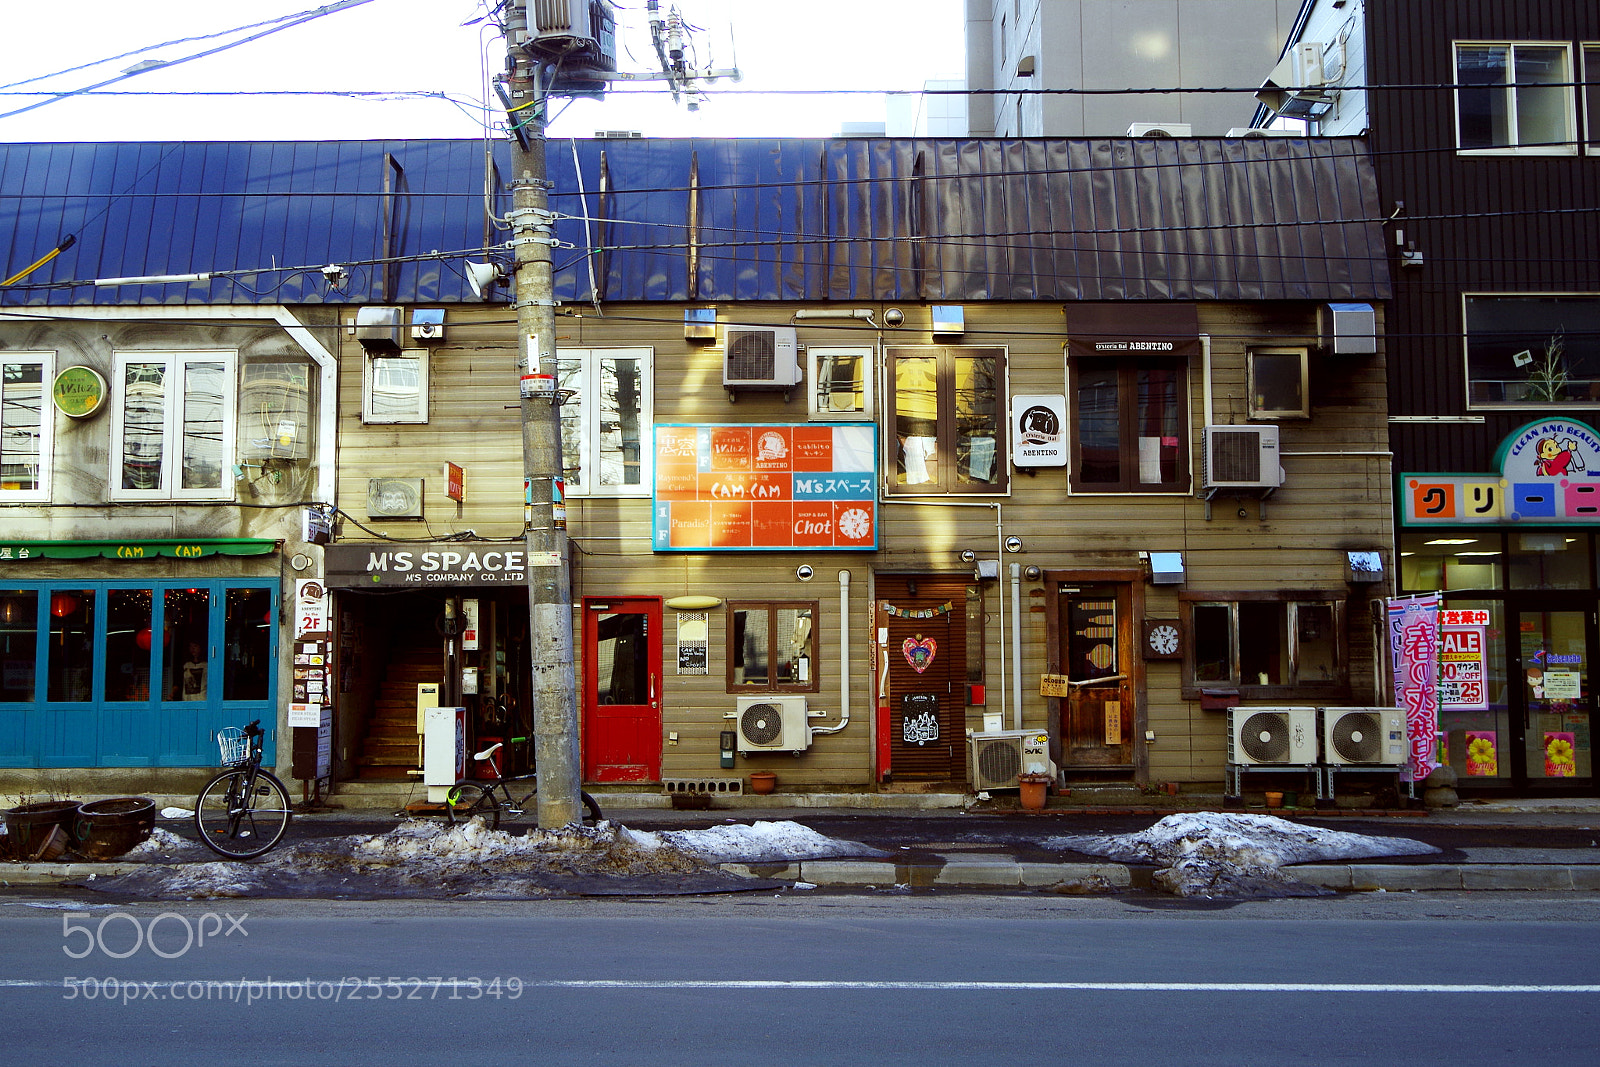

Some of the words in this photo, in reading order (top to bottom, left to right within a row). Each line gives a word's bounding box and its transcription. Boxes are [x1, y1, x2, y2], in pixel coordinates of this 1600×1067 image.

[1130, 342, 1173, 350] ABENTINO
[659, 434, 696, 456] 裏窓
[1512, 429, 1540, 456] CLEAN
[1542, 424, 1564, 434] AND
[657, 474, 696, 483] Raymond's
[1422, 487, 1598, 515] クリーニ
[671, 518, 710, 528] Paradis?
[794, 519, 832, 534] Chot
[116, 545, 144, 558] CAM
[175, 545, 202, 558] CAM
[366, 551, 414, 572] M'S
[420, 551, 525, 572] SPACE
[405, 573, 422, 582] M'S
[426, 573, 475, 582] COMPANY
[302, 616, 321, 630] 2F
[1460, 682, 1481, 698] 25
